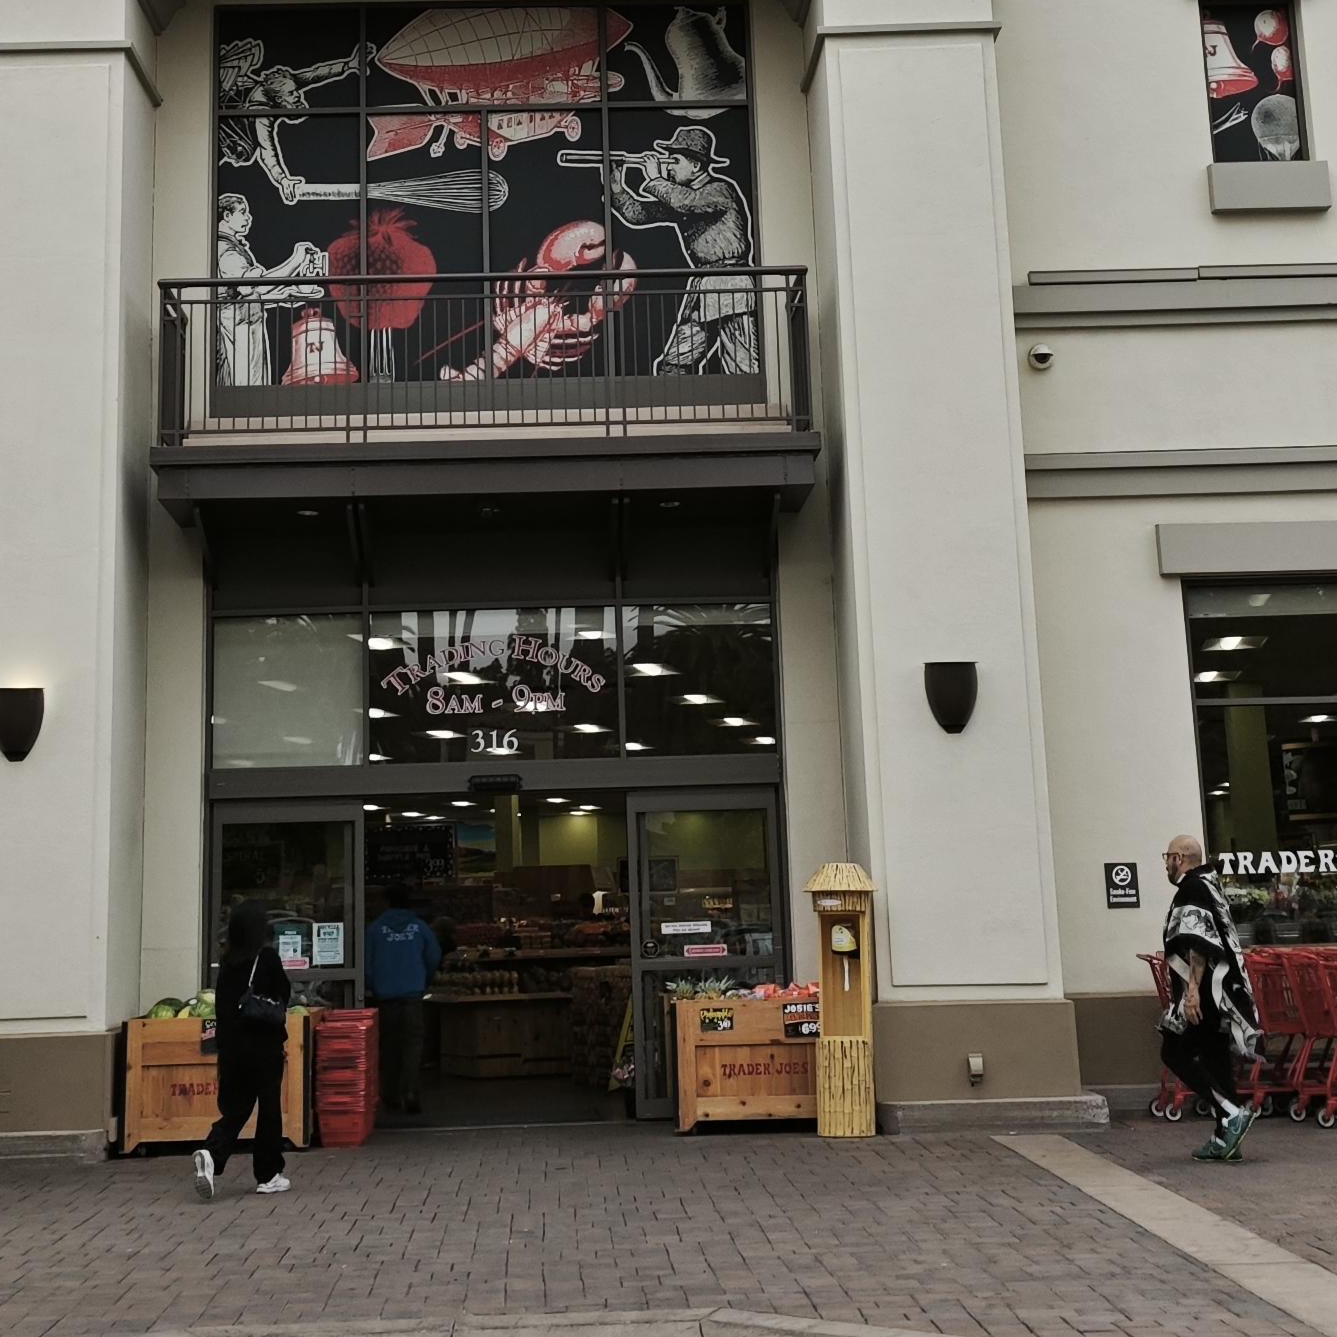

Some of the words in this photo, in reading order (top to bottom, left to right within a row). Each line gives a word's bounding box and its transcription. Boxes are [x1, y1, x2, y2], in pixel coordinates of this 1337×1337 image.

[426, 686, 484, 714] 8AM
[512, 684, 566, 712] 9PM
[470, 729, 519, 753] 316
[1219, 849, 1336, 875] TRADER
[721, 1063, 771, 1077] TRADER
